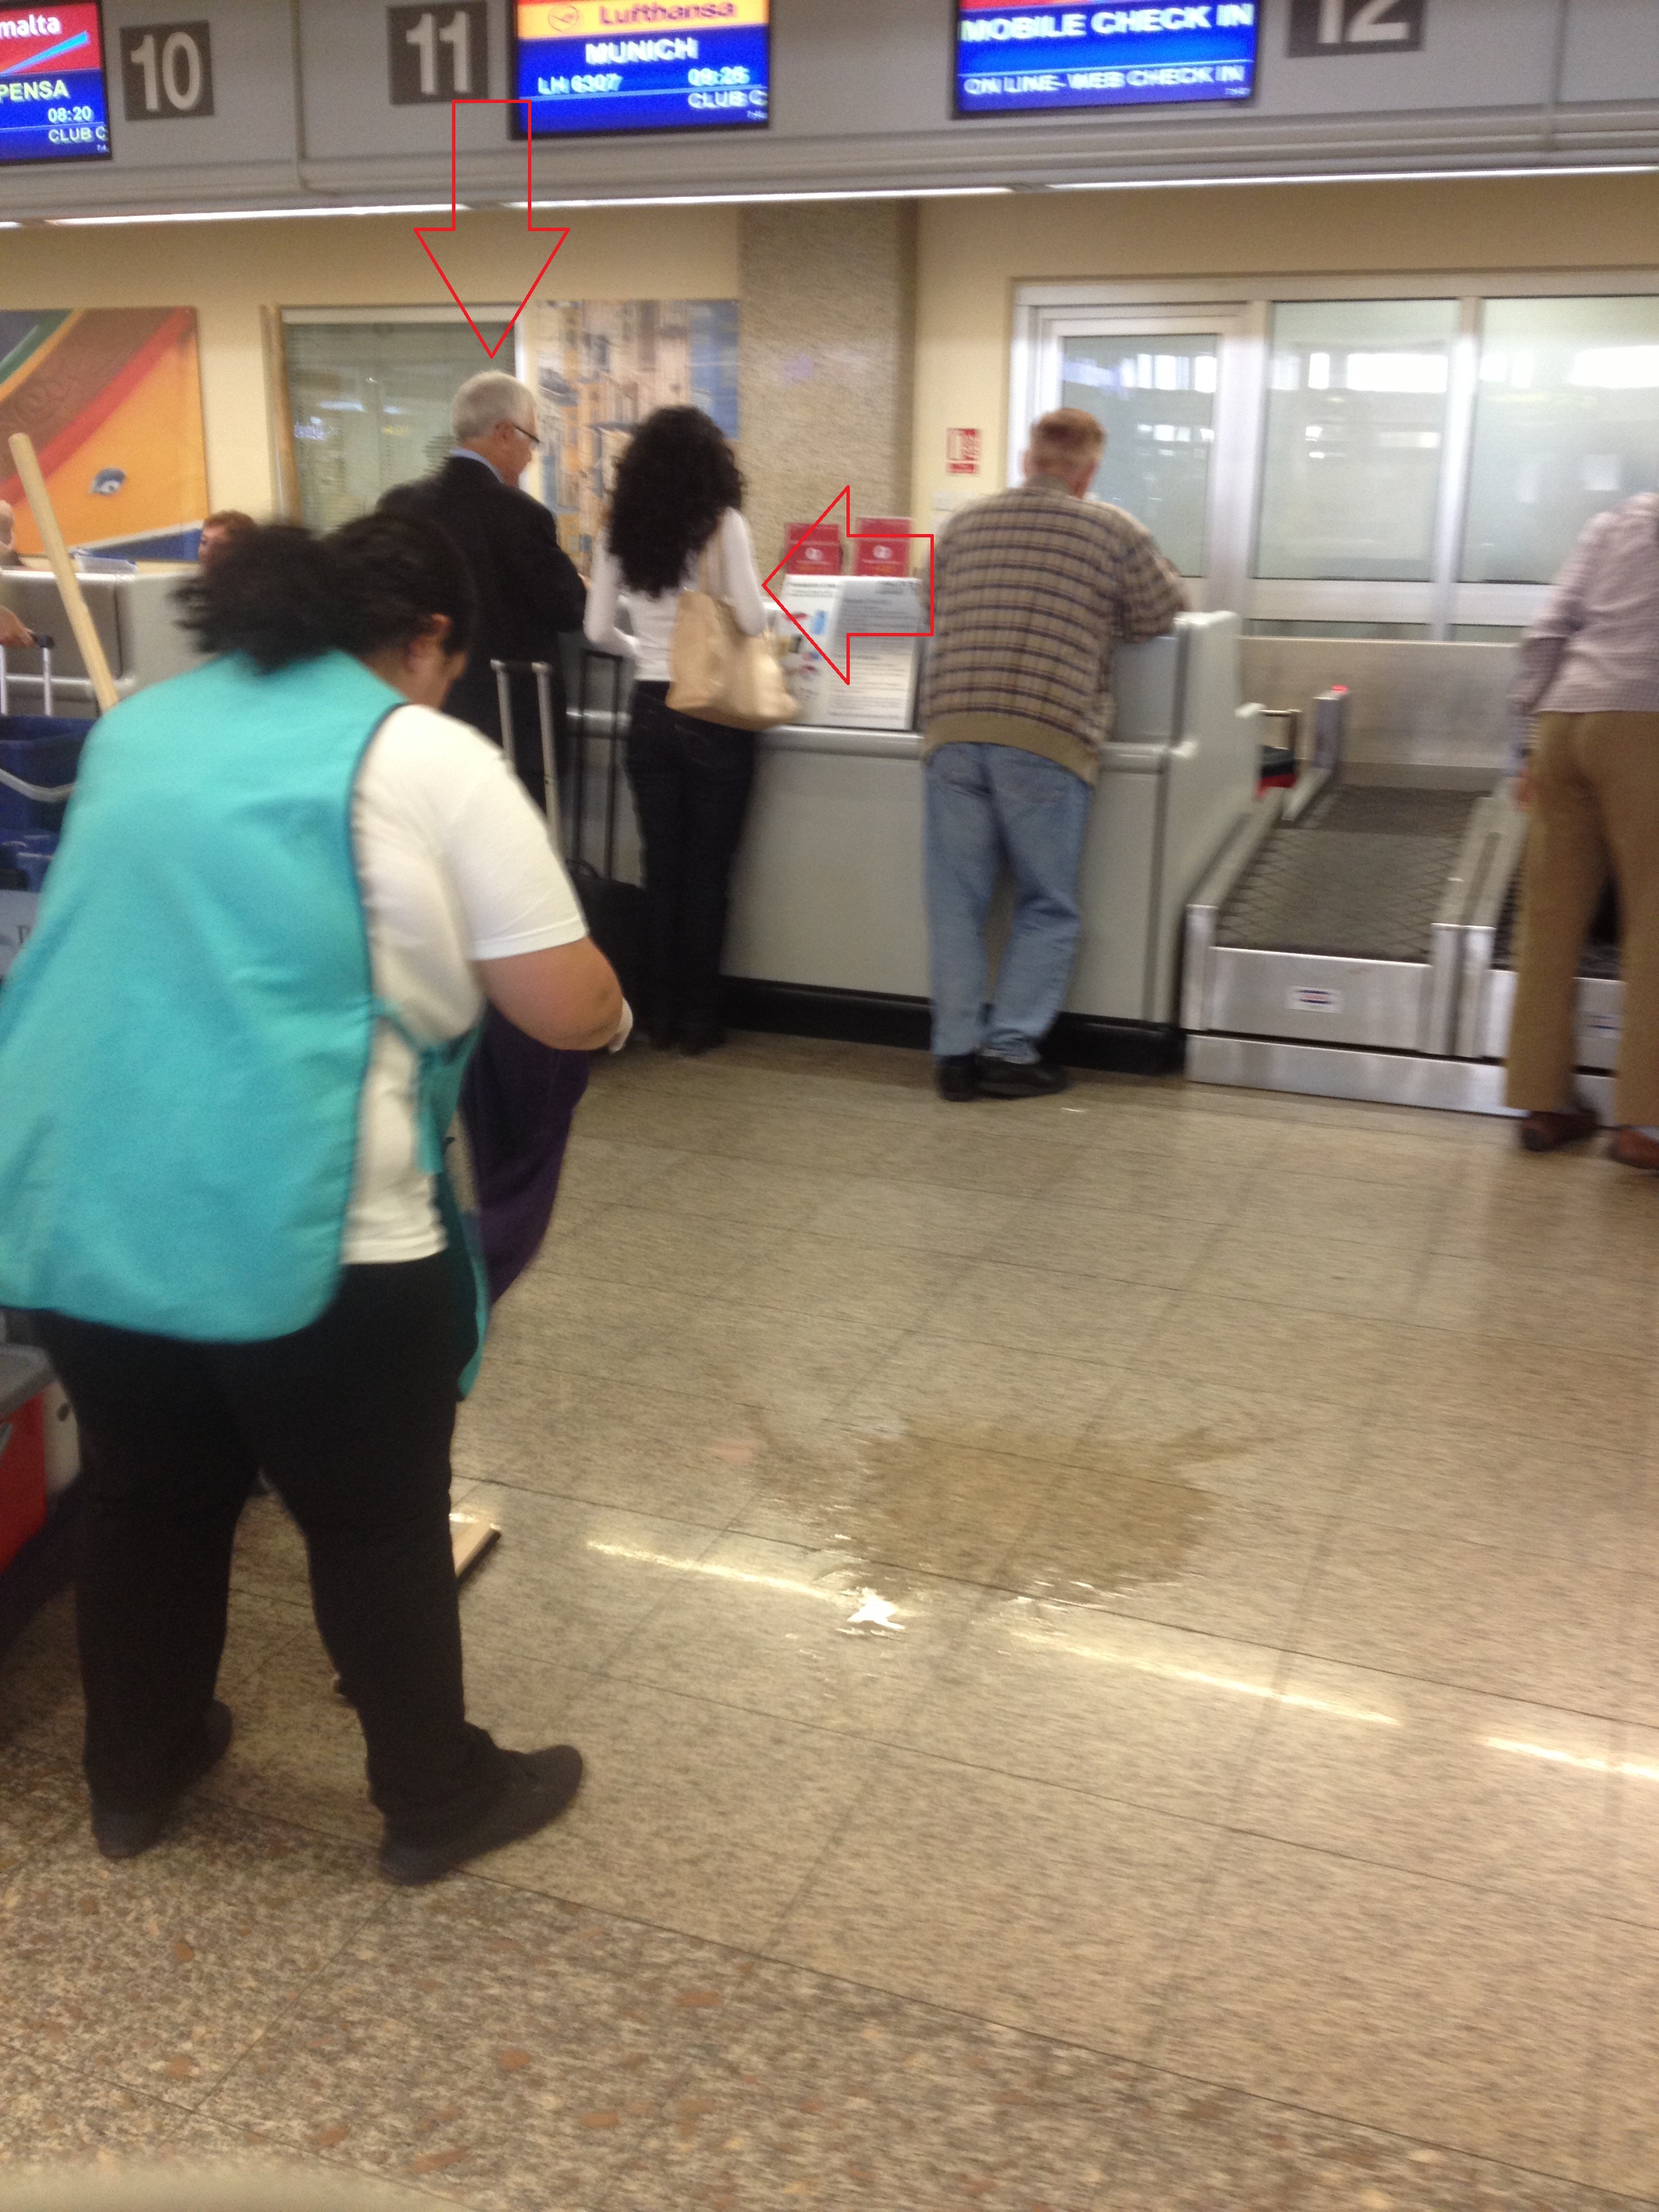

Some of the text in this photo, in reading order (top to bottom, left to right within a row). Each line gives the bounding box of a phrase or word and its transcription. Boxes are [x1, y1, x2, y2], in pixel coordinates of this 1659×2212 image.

[0, 14, 61, 39] malta
[599, 3, 735, 26] Lufthansa
[960, 3, 1254, 42] MOBILE CHECK IN
[407, 10, 472, 95] 11
[585, 37, 699, 65] MUNICH
[131, 31, 201, 111] 10
[963, 77, 1002, 96] ON
[1067, 71, 1126, 89] WEB
[1126, 66, 1215, 87] CHECK
[1214, 64, 1244, 82] IN
[537, 75, 571, 96] LH
[687, 90, 747, 110] CLUB
[47, 105, 96, 124] 08:20
[47, 127, 95, 144] CLUB
